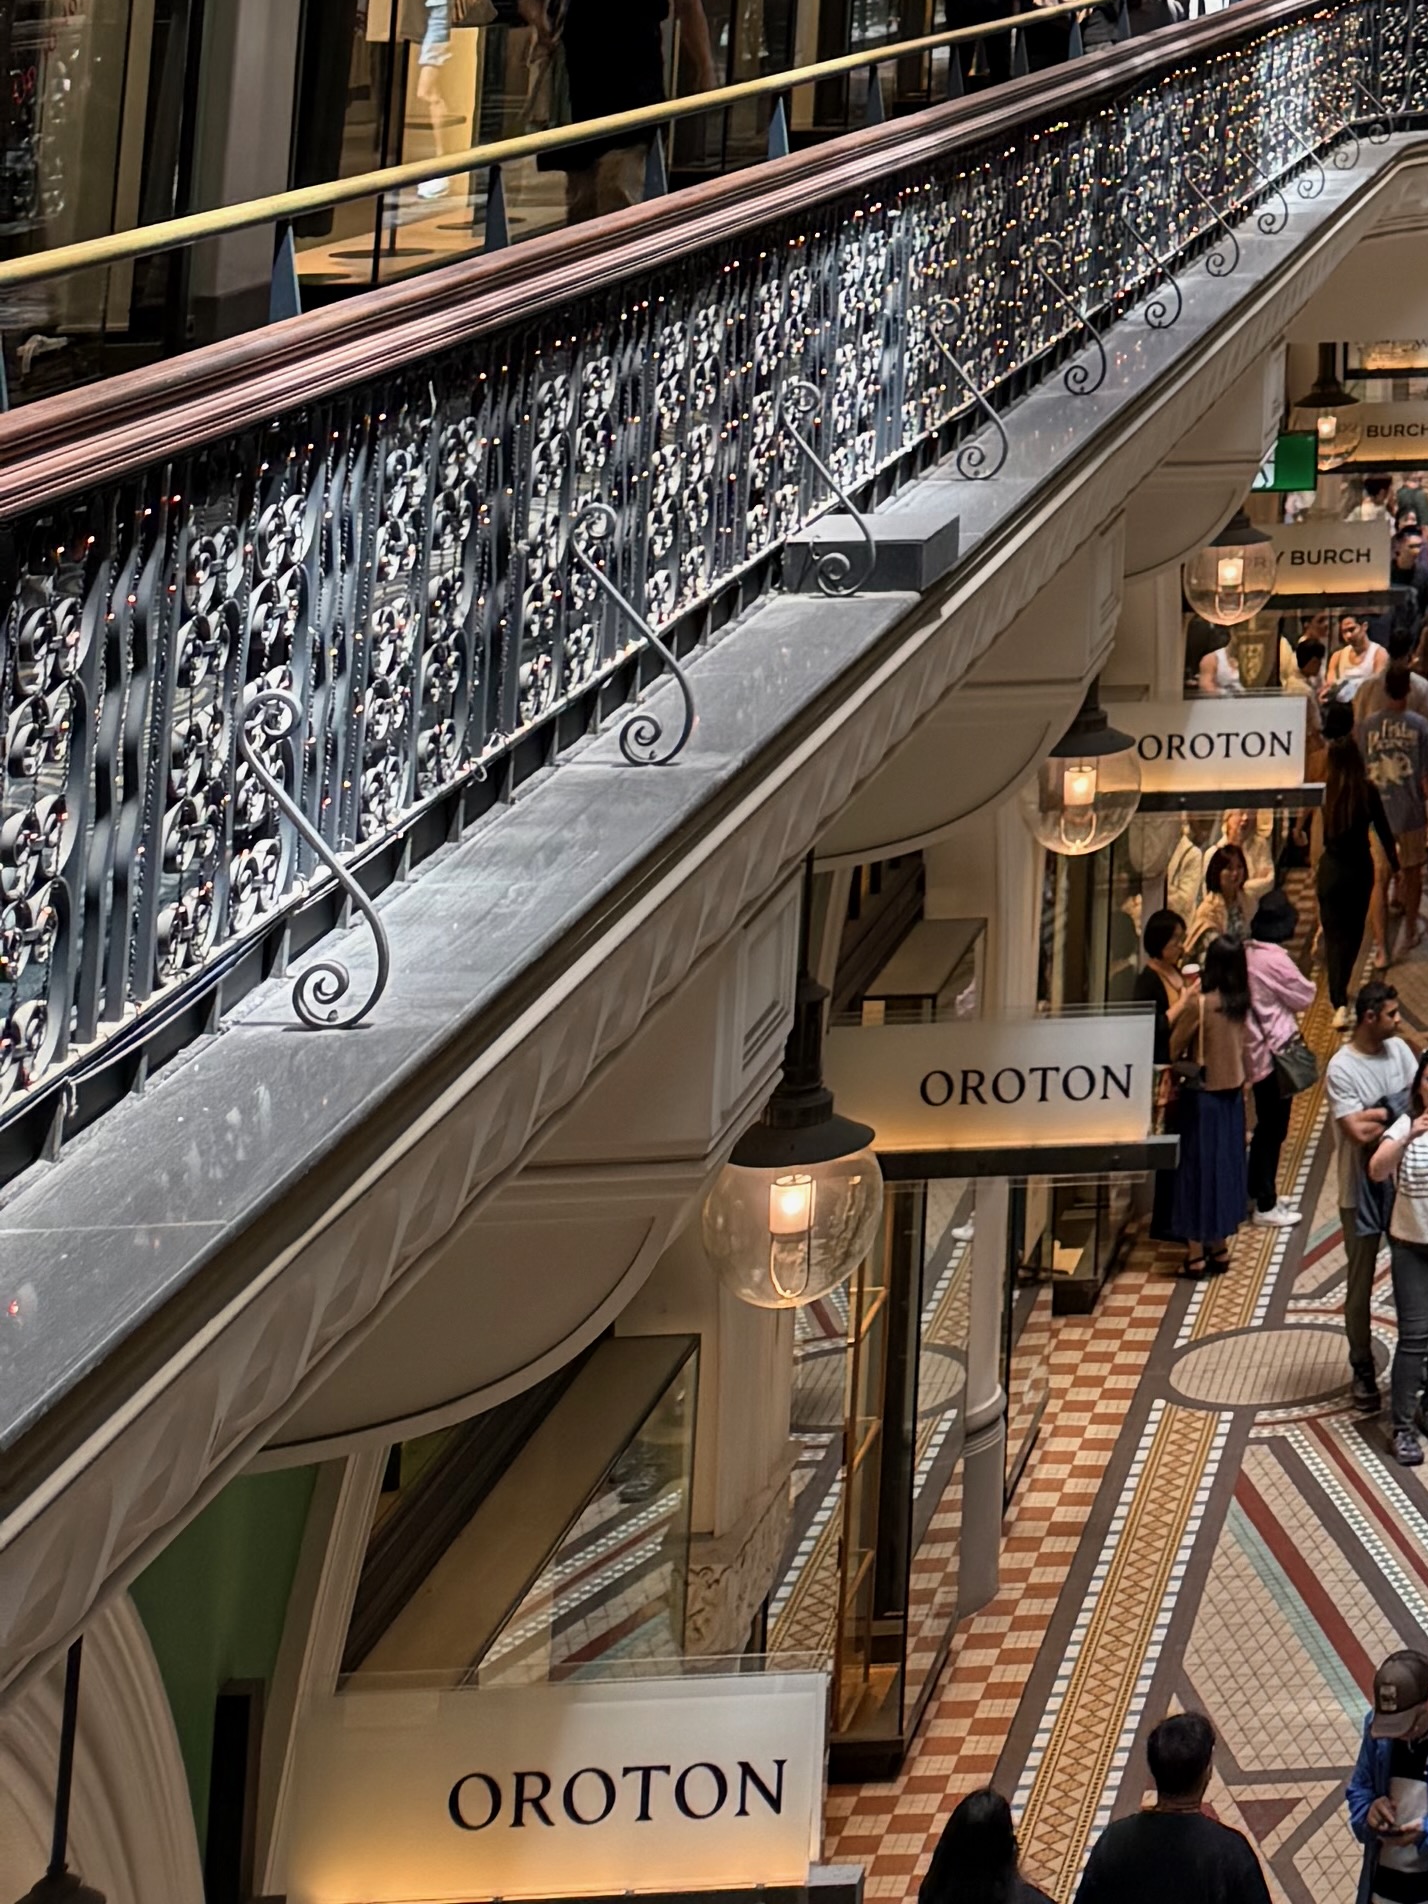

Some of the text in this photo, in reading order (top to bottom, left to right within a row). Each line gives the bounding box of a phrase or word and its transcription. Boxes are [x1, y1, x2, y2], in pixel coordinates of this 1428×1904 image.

[1290, 547, 1372, 566] BURCH
[1136, 728, 1294, 761] OROTON
[919, 1063, 1134, 1107] OROTON
[447, 1756, 787, 1832] OROTON
